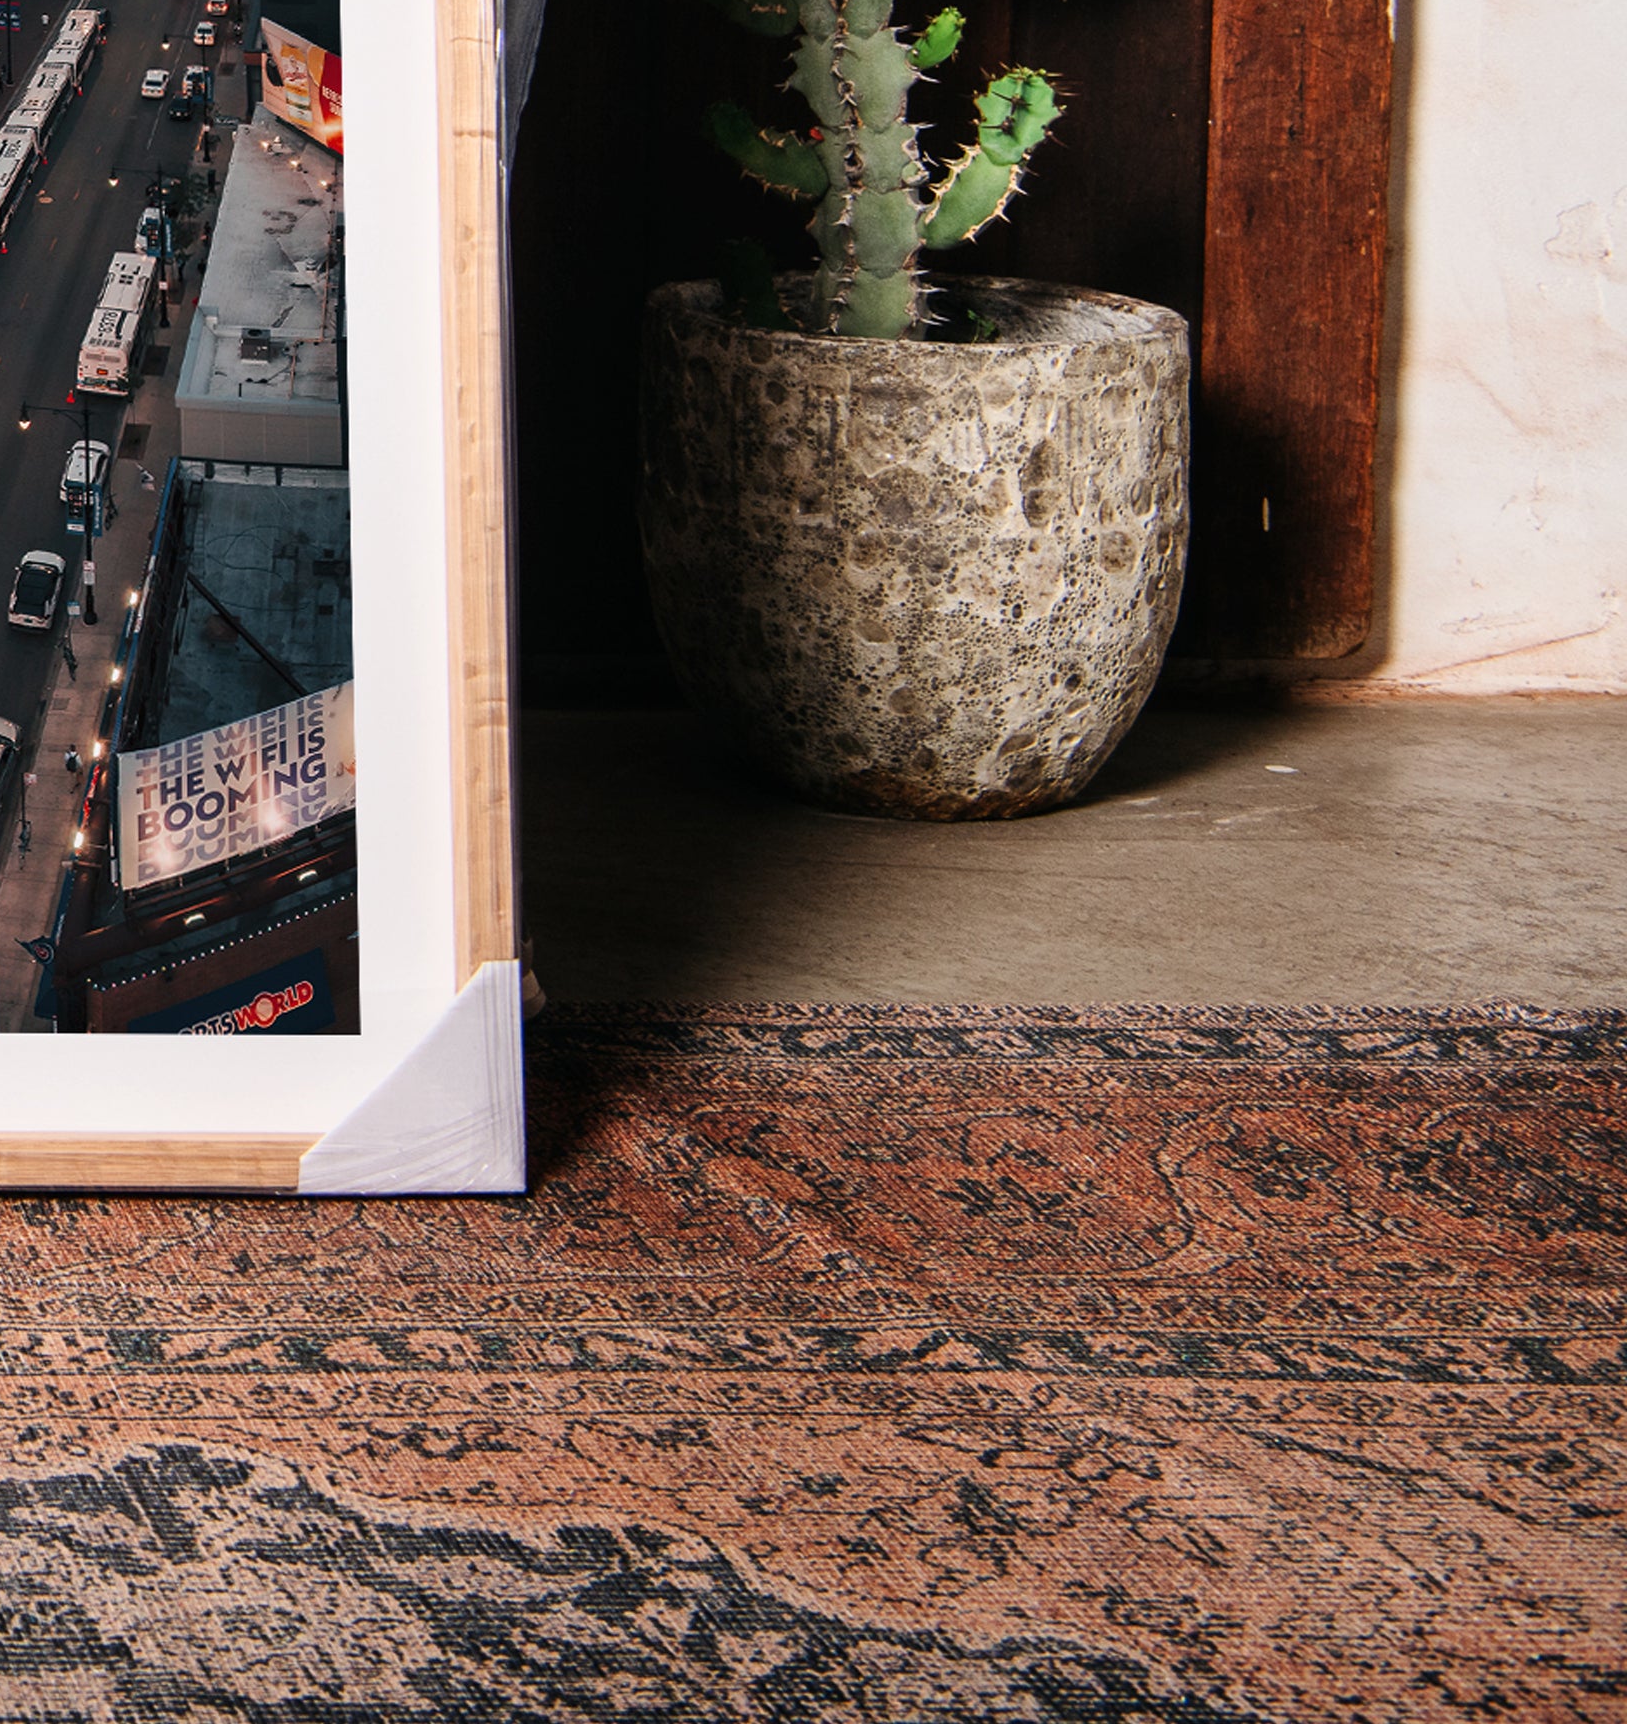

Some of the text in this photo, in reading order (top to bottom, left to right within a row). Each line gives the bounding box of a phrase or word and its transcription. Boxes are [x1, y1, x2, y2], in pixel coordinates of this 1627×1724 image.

[136, 726, 326, 811] THE WIFI IS
[137, 752, 327, 843] BOOMING
[234, 980, 315, 1032] WORLD
